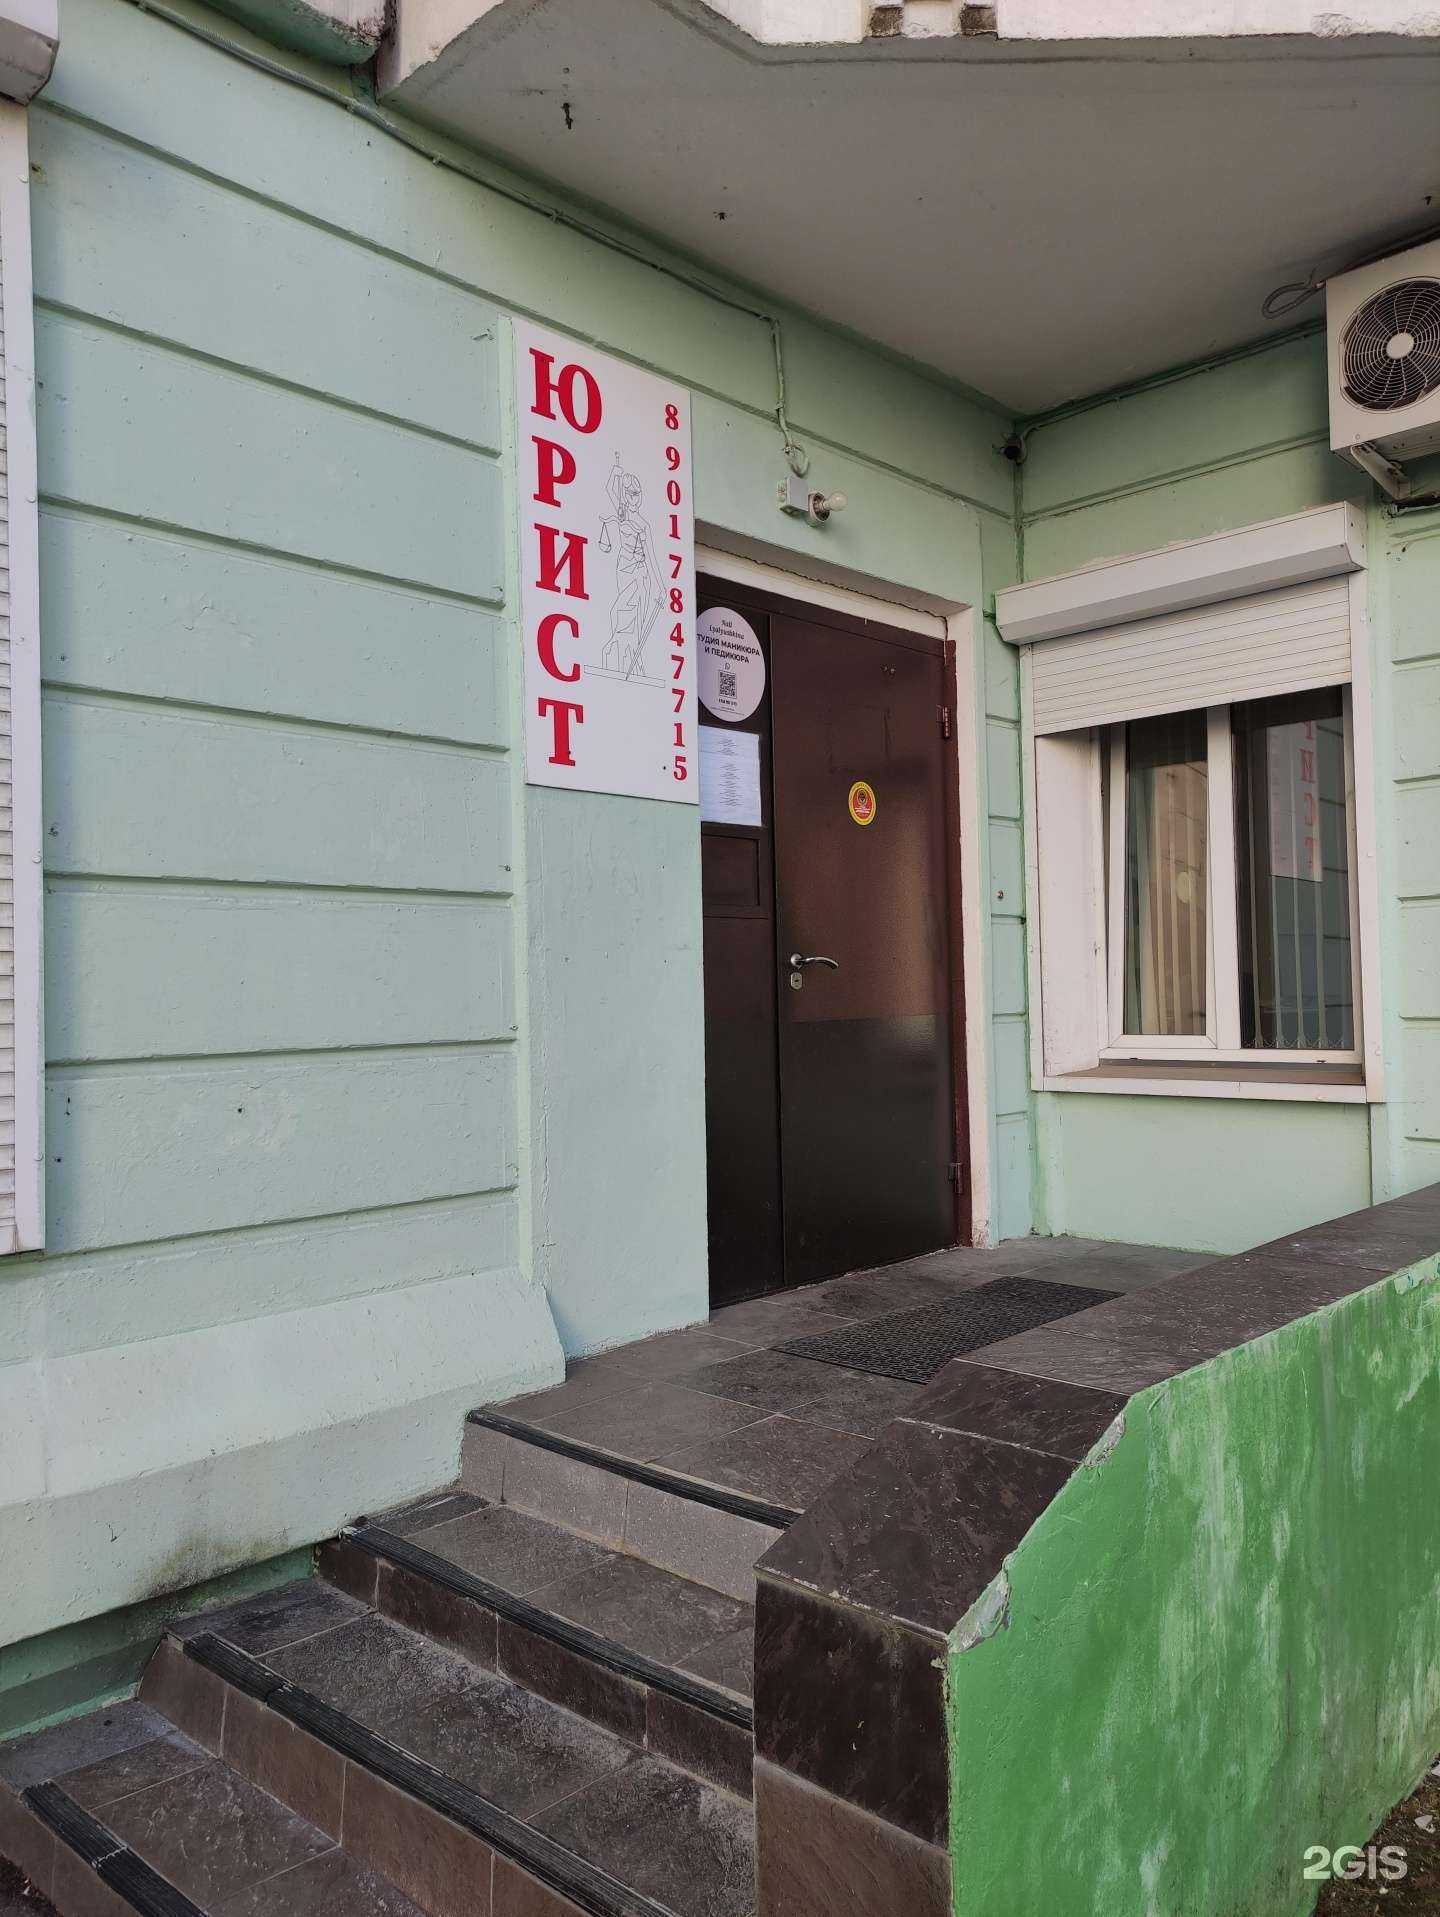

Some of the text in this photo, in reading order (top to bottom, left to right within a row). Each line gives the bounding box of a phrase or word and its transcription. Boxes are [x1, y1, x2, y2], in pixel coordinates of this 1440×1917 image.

[529, 347, 602, 767] ЮРИСТ
[697, 633, 760, 656] ТУДИЯ МАНИКЮРА
[704, 646, 750, 663] И ПЕДИКЮРА
